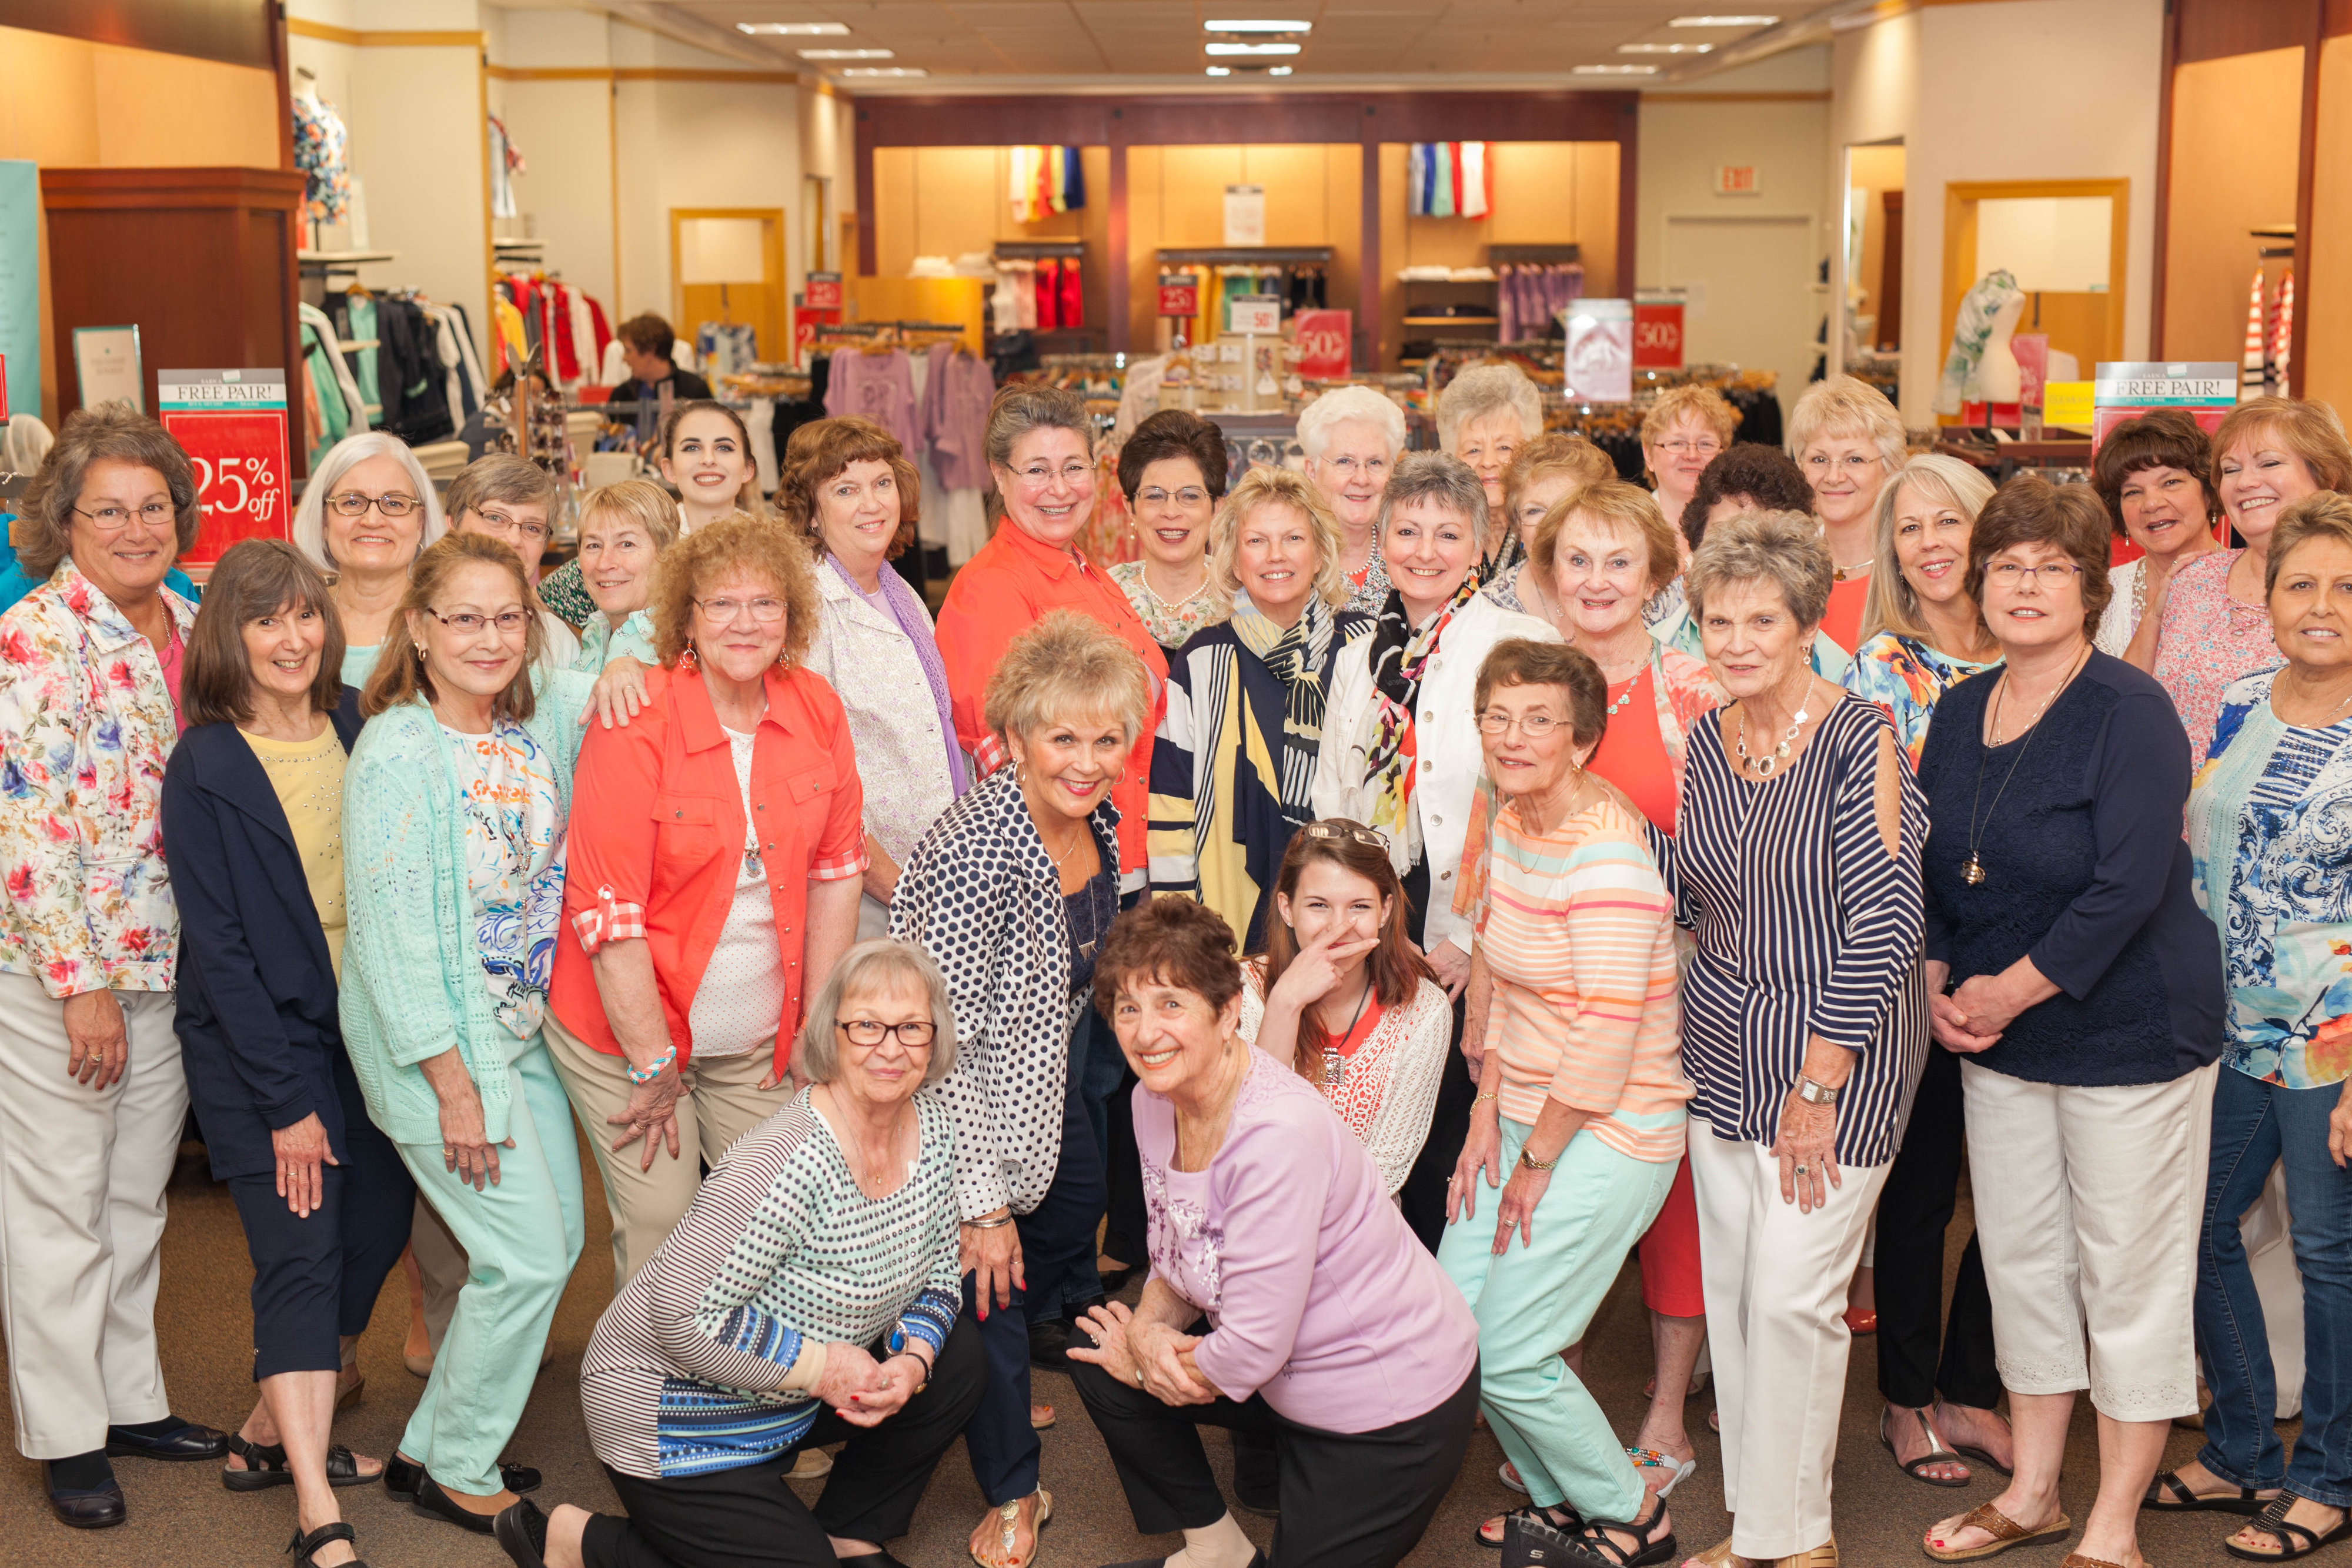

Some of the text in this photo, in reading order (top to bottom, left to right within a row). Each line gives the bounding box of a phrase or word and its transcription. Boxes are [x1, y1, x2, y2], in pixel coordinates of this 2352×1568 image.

[178, 385, 272, 399] FREE PAIR!
[2117, 380, 2220, 395] FREE PAIR!
[189, 457, 274, 516] 25%
[248, 488, 280, 522] off
